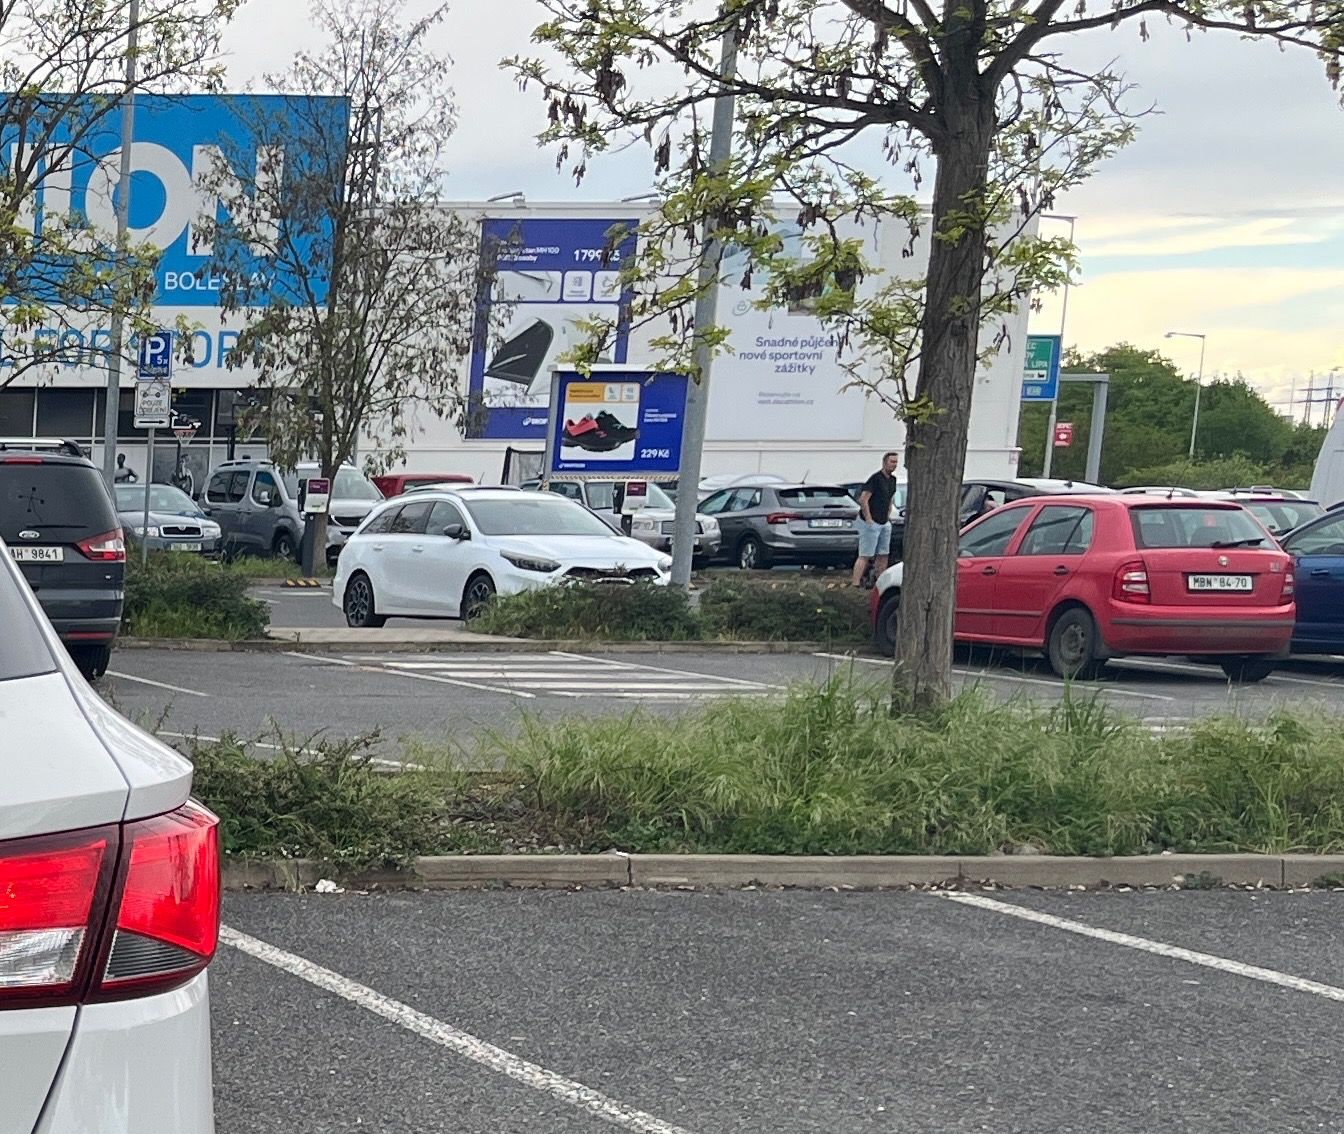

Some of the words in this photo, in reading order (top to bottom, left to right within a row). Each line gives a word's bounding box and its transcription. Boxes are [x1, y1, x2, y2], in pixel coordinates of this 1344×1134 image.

[574, 249, 602, 261] 1799
[164, 271, 276, 291] BOLELA
[755, 336, 799, 348] Snadné
[800, 335, 842, 350] půjčen
[145, 336, 166, 364] P
[739, 350, 767, 361] nové
[768, 350, 823, 362] sportovní
[774, 362, 816, 375] zážitky
[640, 448, 658, 459] 229
[31, 548, 59, 560] 9841
[1193, 576, 1213, 588] MBN
